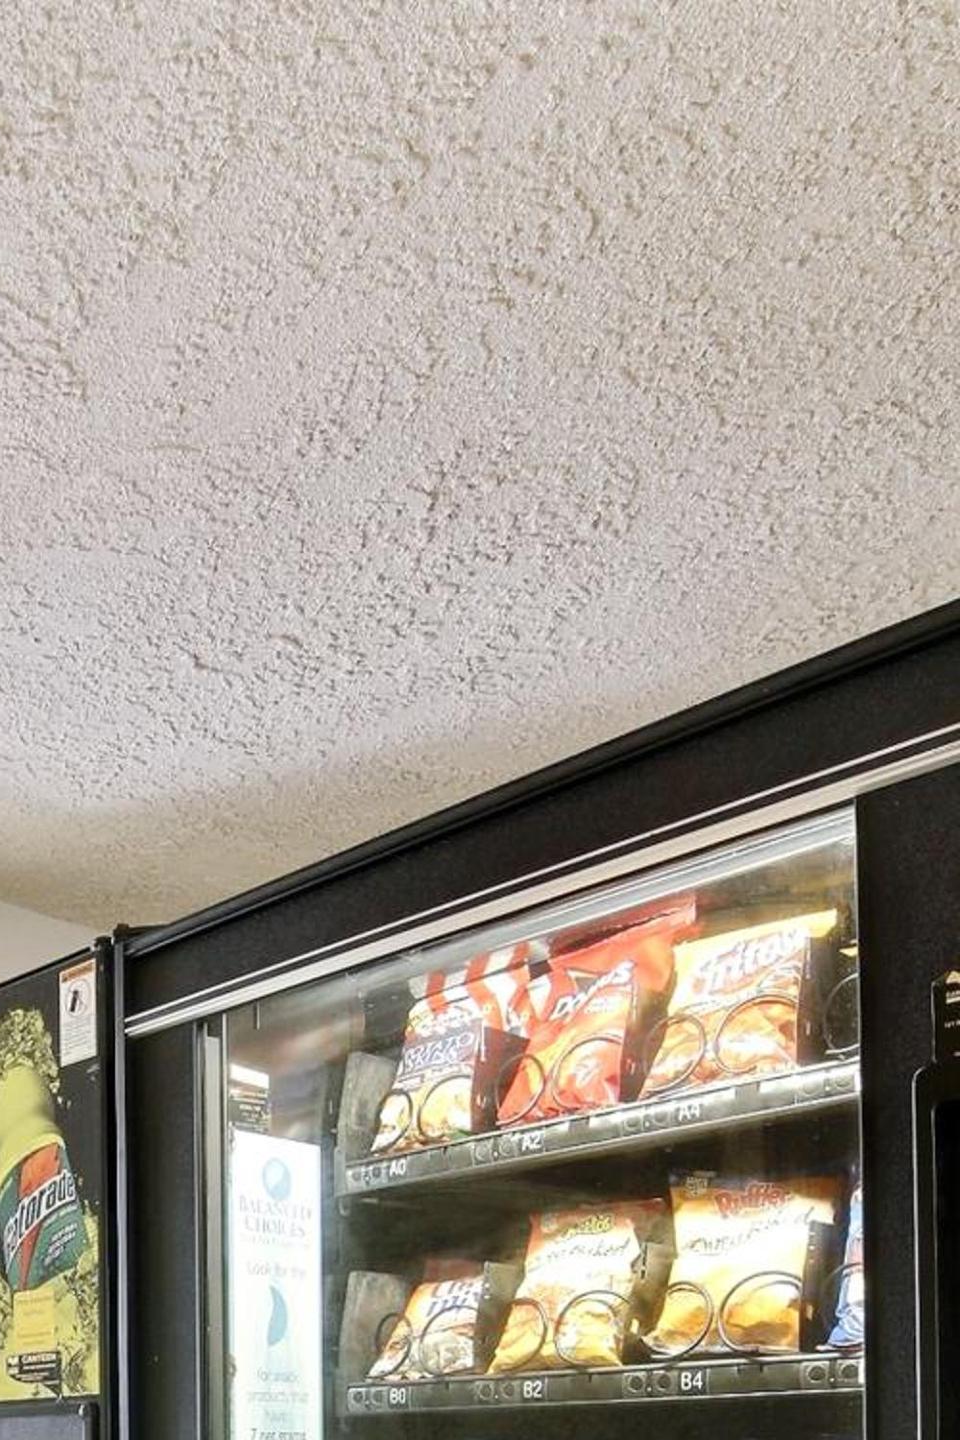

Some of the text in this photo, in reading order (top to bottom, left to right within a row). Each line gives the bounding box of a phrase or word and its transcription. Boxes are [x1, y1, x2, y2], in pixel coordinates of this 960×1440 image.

[389, 1102, 701, 1176] A0 A2 A4
[390, 1371, 703, 1404] B0 B2 B4
